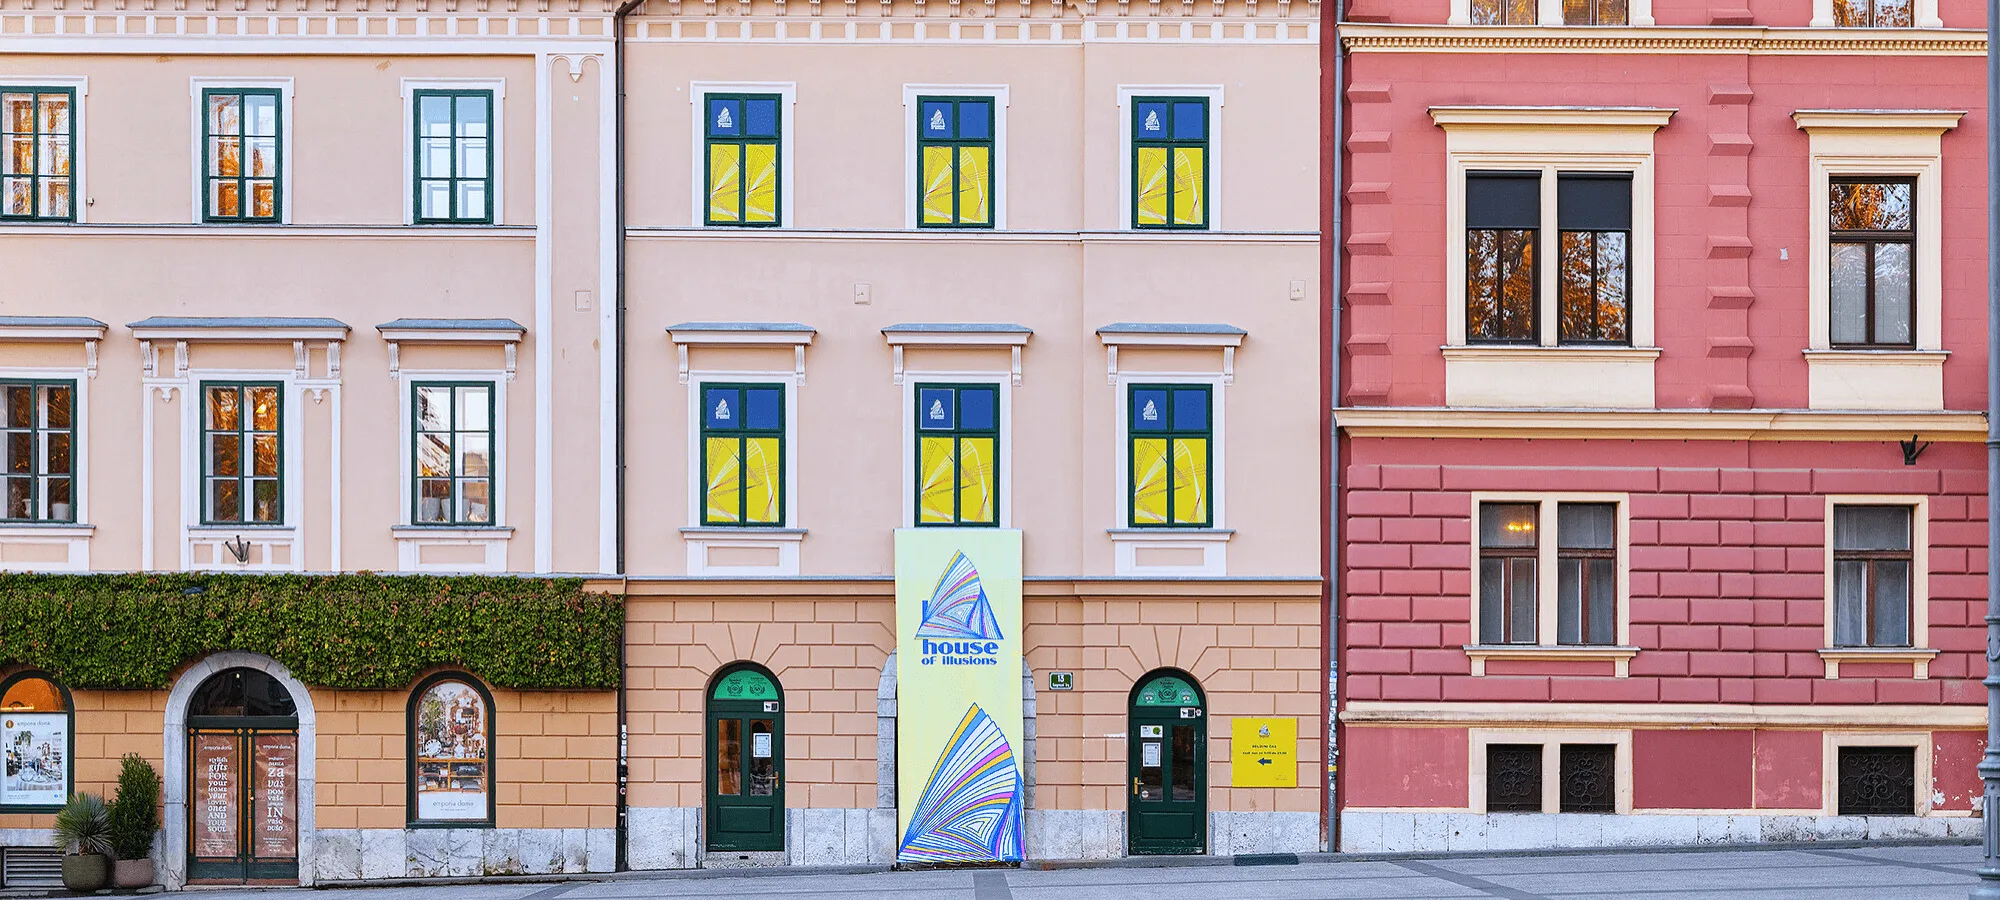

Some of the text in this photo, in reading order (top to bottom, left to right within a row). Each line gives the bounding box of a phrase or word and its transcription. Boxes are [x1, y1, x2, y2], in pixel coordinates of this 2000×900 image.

[922, 639, 999, 655] house
[921, 656, 998, 665] of illusions
[209, 762, 228, 771] gifts
[267, 768, 285, 778] za
[267, 806, 284, 818] IN
